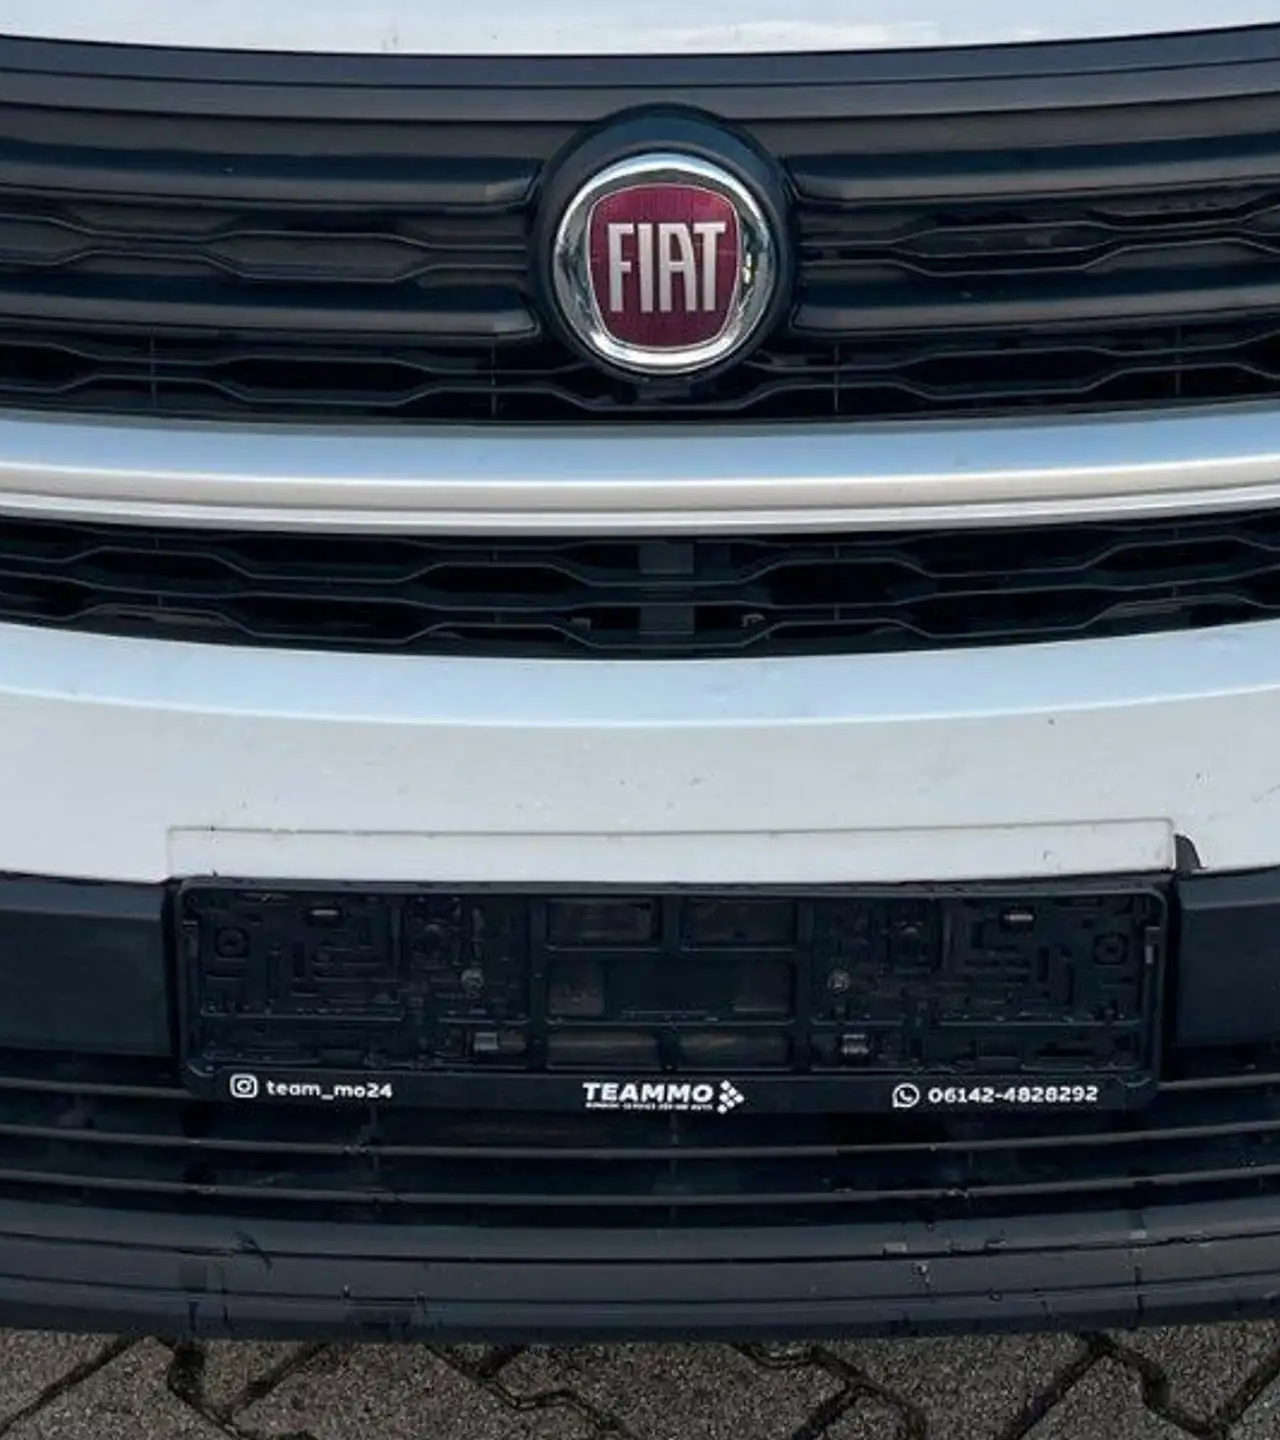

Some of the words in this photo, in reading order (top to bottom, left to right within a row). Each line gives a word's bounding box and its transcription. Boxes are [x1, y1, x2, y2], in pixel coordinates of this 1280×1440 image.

[608, 222, 726, 313] FIAT
[266, 1080, 393, 1101] team_mo24
[582, 1082, 714, 1103] TEAMMO
[927, 1085, 1099, 1104] 06142-4828292
